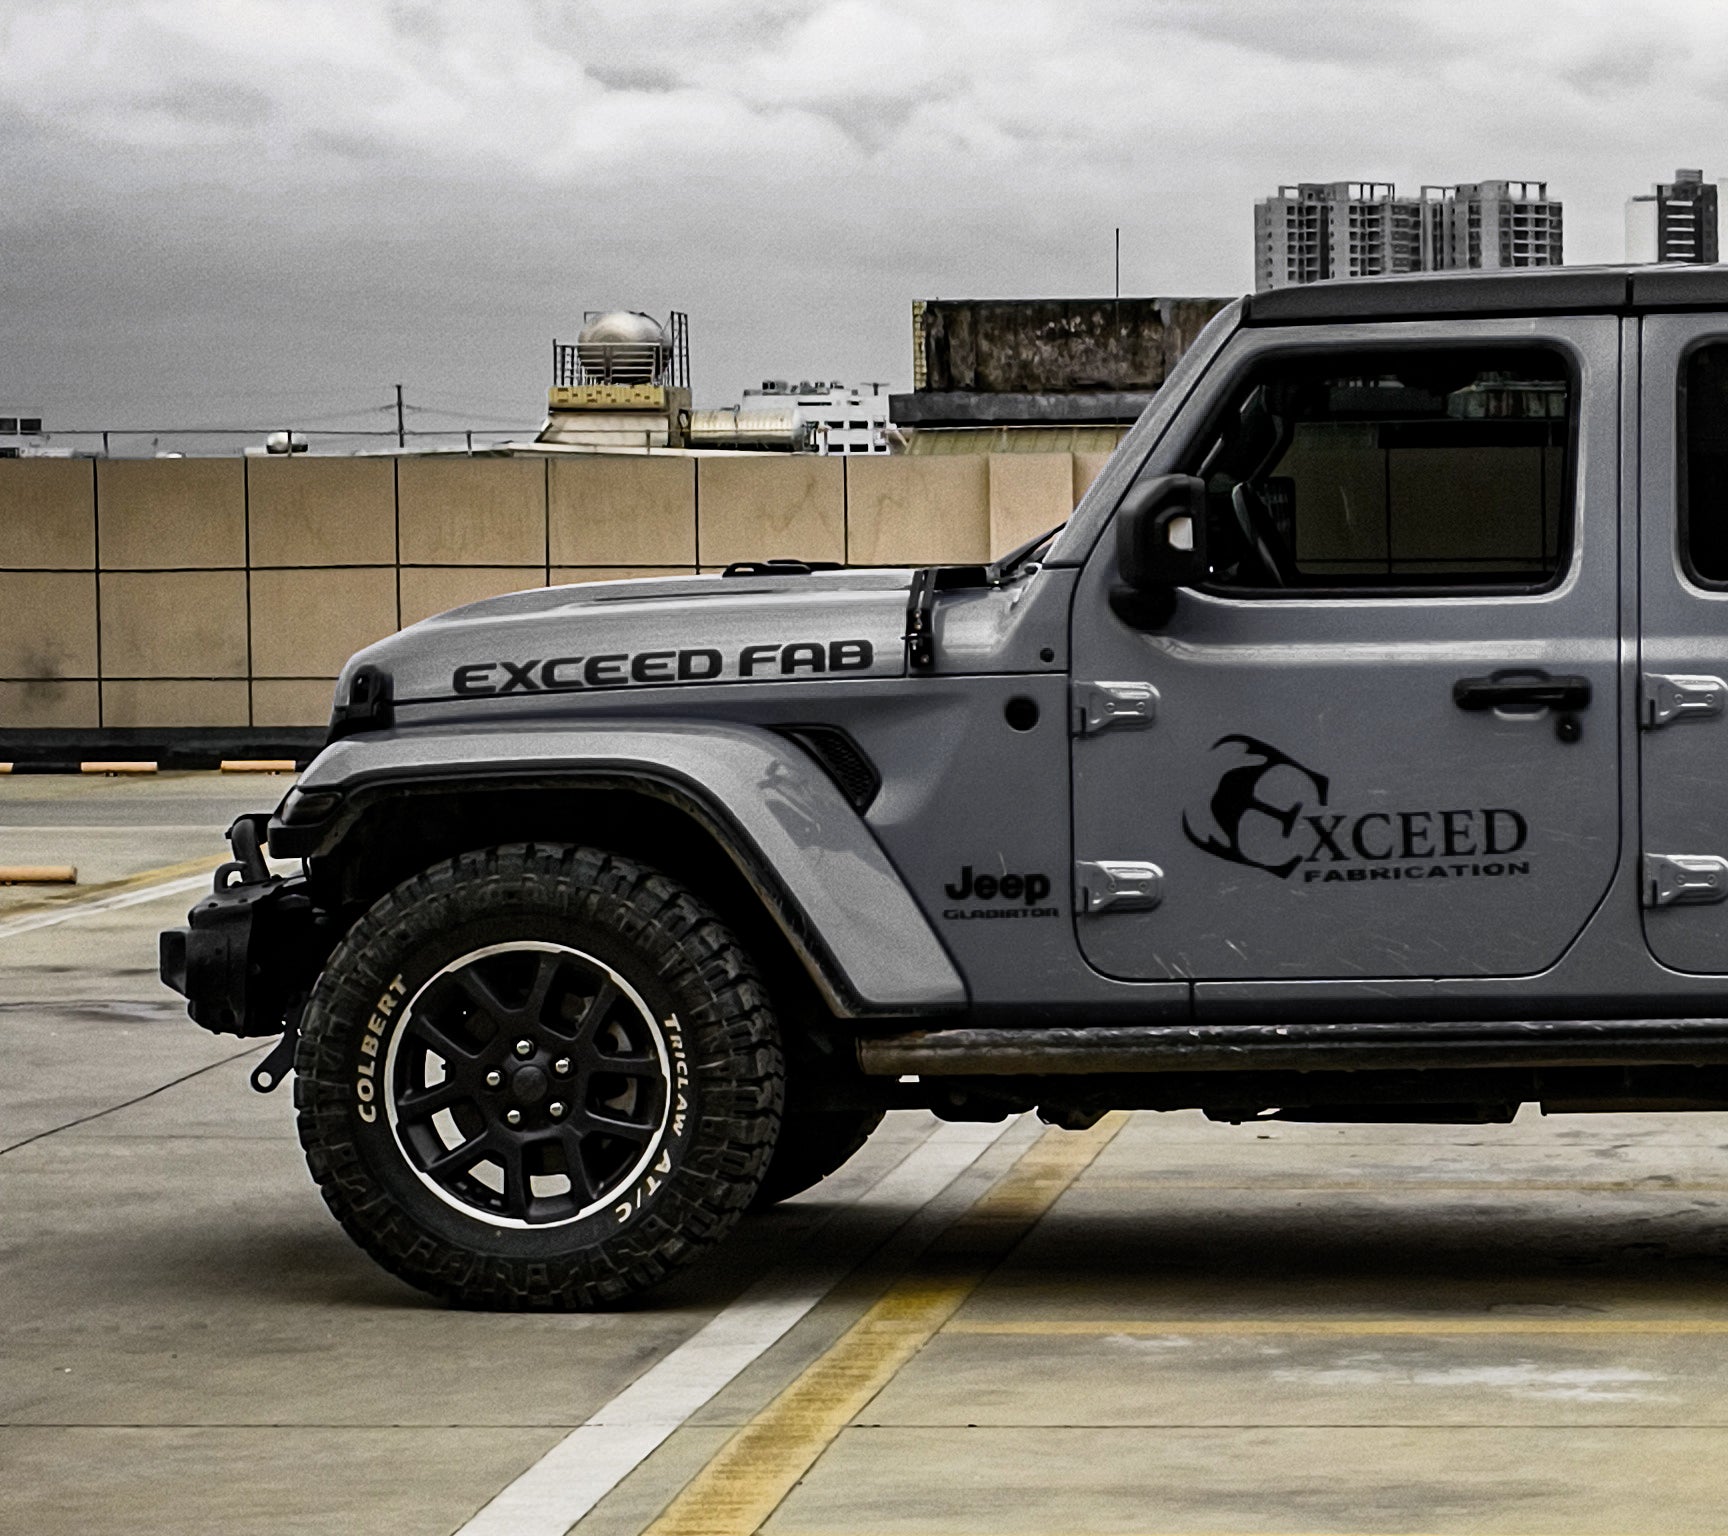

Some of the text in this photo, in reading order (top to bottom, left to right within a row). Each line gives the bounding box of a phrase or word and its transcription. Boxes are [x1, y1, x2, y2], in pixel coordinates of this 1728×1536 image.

[451, 639, 875, 696] EXCEED FAB
[944, 864, 1051, 906] Jeep
[1303, 862, 1531, 883] FABRICATION
[356, 973, 407, 1124] COLBERT
[615, 1012, 692, 1224] TRICLAW AT/C
